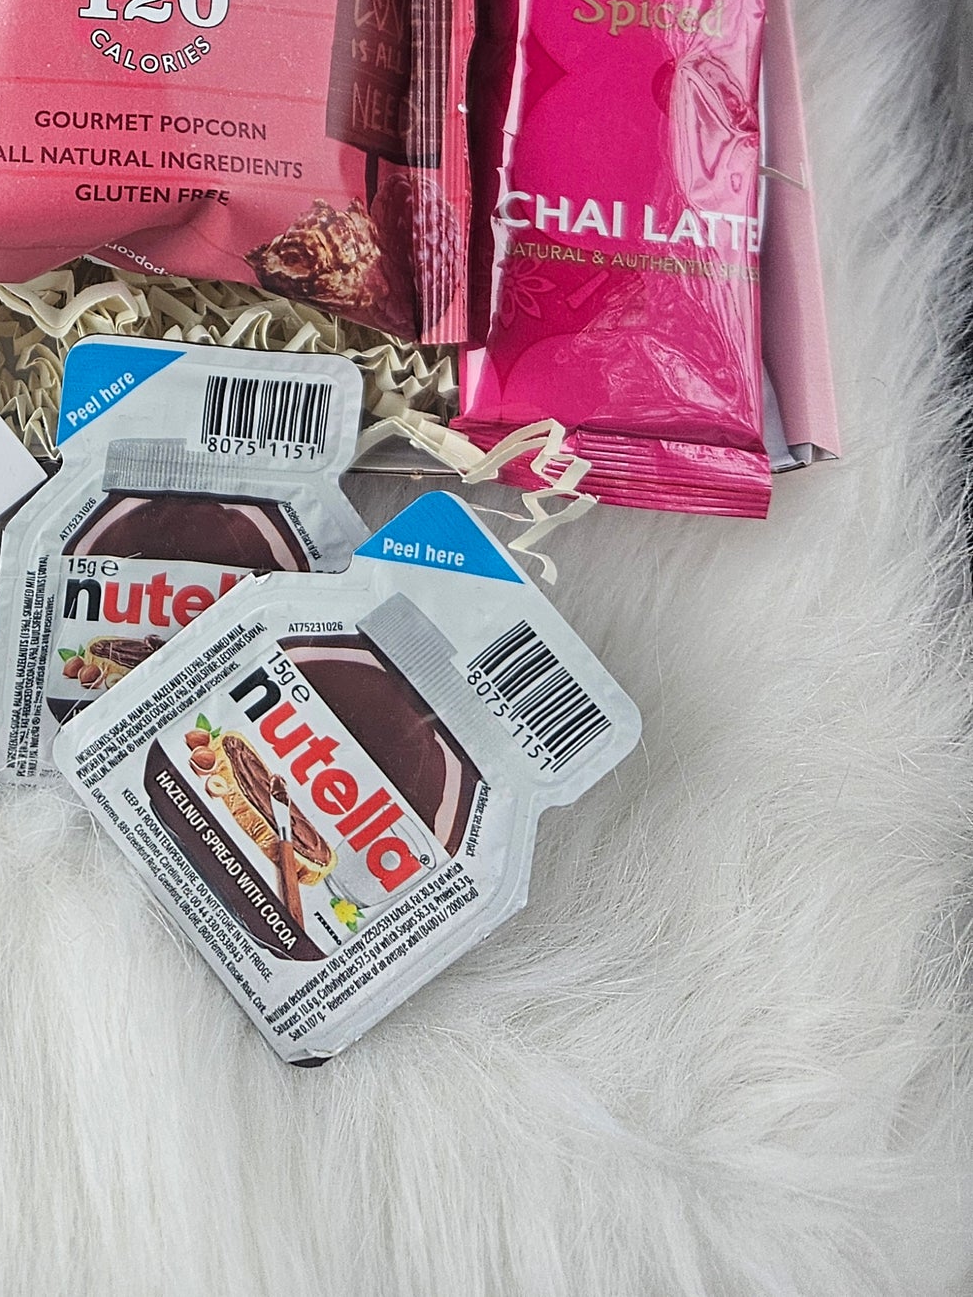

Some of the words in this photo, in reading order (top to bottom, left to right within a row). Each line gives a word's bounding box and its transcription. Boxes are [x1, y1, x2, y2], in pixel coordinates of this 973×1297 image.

[90, 29, 211, 73] CALORIES
[352, 38, 368, 62] IS
[34, 110, 153, 132] GOURMET
[160, 115, 266, 140] POPCORN
[41, 146, 153, 168] NATURAL
[161, 152, 302, 179] INGREDIENTS
[75, 184, 170, 203] GLUTEN
[178, 188, 229, 206] FREE
[498, 191, 622, 238] CHAI
[592, 251, 603, 263] &
[611, 253, 713, 276] AUTHENTIC
[64, 395, 101, 427] Peel
[97, 369, 136, 402] here
[207, 435, 256, 456] 8075
[268, 440, 315, 460] 1151
[57, 494, 97, 543] AT75231026
[67, 559, 96, 576] 15g
[382, 537, 420, 559] Peel
[424, 544, 465, 566] here
[25, 569, 35, 587] MILK
[288, 621, 343, 632] AT75231026
[126, 704, 145, 723] PALM
[151, 670, 189, 703] HAZELNUTS
[201, 635, 231, 661] SKIMMED
[225, 622, 246, 642] MILK
[148, 699, 170, 719] COCOA
[215, 637, 247, 665] LECITHINS
[262, 649, 298, 687] 15g
[132, 733, 146, 747] free
[142, 723, 158, 739] from
[192, 684, 207, 698] and
[465, 669, 509, 719] 8075
[508, 721, 552, 771] 1151
[230, 666, 423, 891] nutella
[155, 769, 209, 833] HAZELNUT
[200, 827, 243, 877] SPREAD
[235, 872, 267, 908] WITH
[258, 902, 299, 950] COCOA
[121, 787, 140, 808] KEEP
[134, 804, 147, 817] AT
[141, 813, 163, 838] ROOM
[157, 834, 201, 886] TEMPERATURE.
[195, 883, 209, 897] DO
[203, 894, 220, 912] NOT
[214, 908, 237, 933] STORE
[231, 929, 243, 941] IN
[237, 938, 253, 955] THE
[248, 951, 274, 983] FRIDGE.
[125, 831, 150, 861] Greenford
[156, 872, 184, 904] Greenford,
[224, 960, 245, 984] Kinsale
[132, 822, 163, 859] Consumer
[158, 855, 184, 885] Careline
[188, 894, 202, 908] 00
[196, 905, 209, 918] 44
[204, 914, 220, 932] 330
[215, 929, 244, 963] 0538943
[315, 967, 330, 982] per
[325, 957, 341, 973] 100
[342, 937, 367, 960] Energy
[360, 915, 393, 944] 2252/539
[408, 891, 423, 906] Fat
[417, 881, 436, 899] 30.9
[441, 860, 464, 881] which
[297, 999, 315, 1016] 10.6
[353, 951, 372, 969] 57.5
[377, 929, 399, 950] which
[394, 914, 419, 937] Sugars
[413, 904, 431, 922] 56.3
[432, 883, 457, 906] Protein
[452, 877, 467, 892] 6.3
[298, 1013, 320, 1034] 0.107
[325, 982, 357, 1011] Reference
[383, 941, 410, 967] average
[445, 896, 465, 915] 2000
